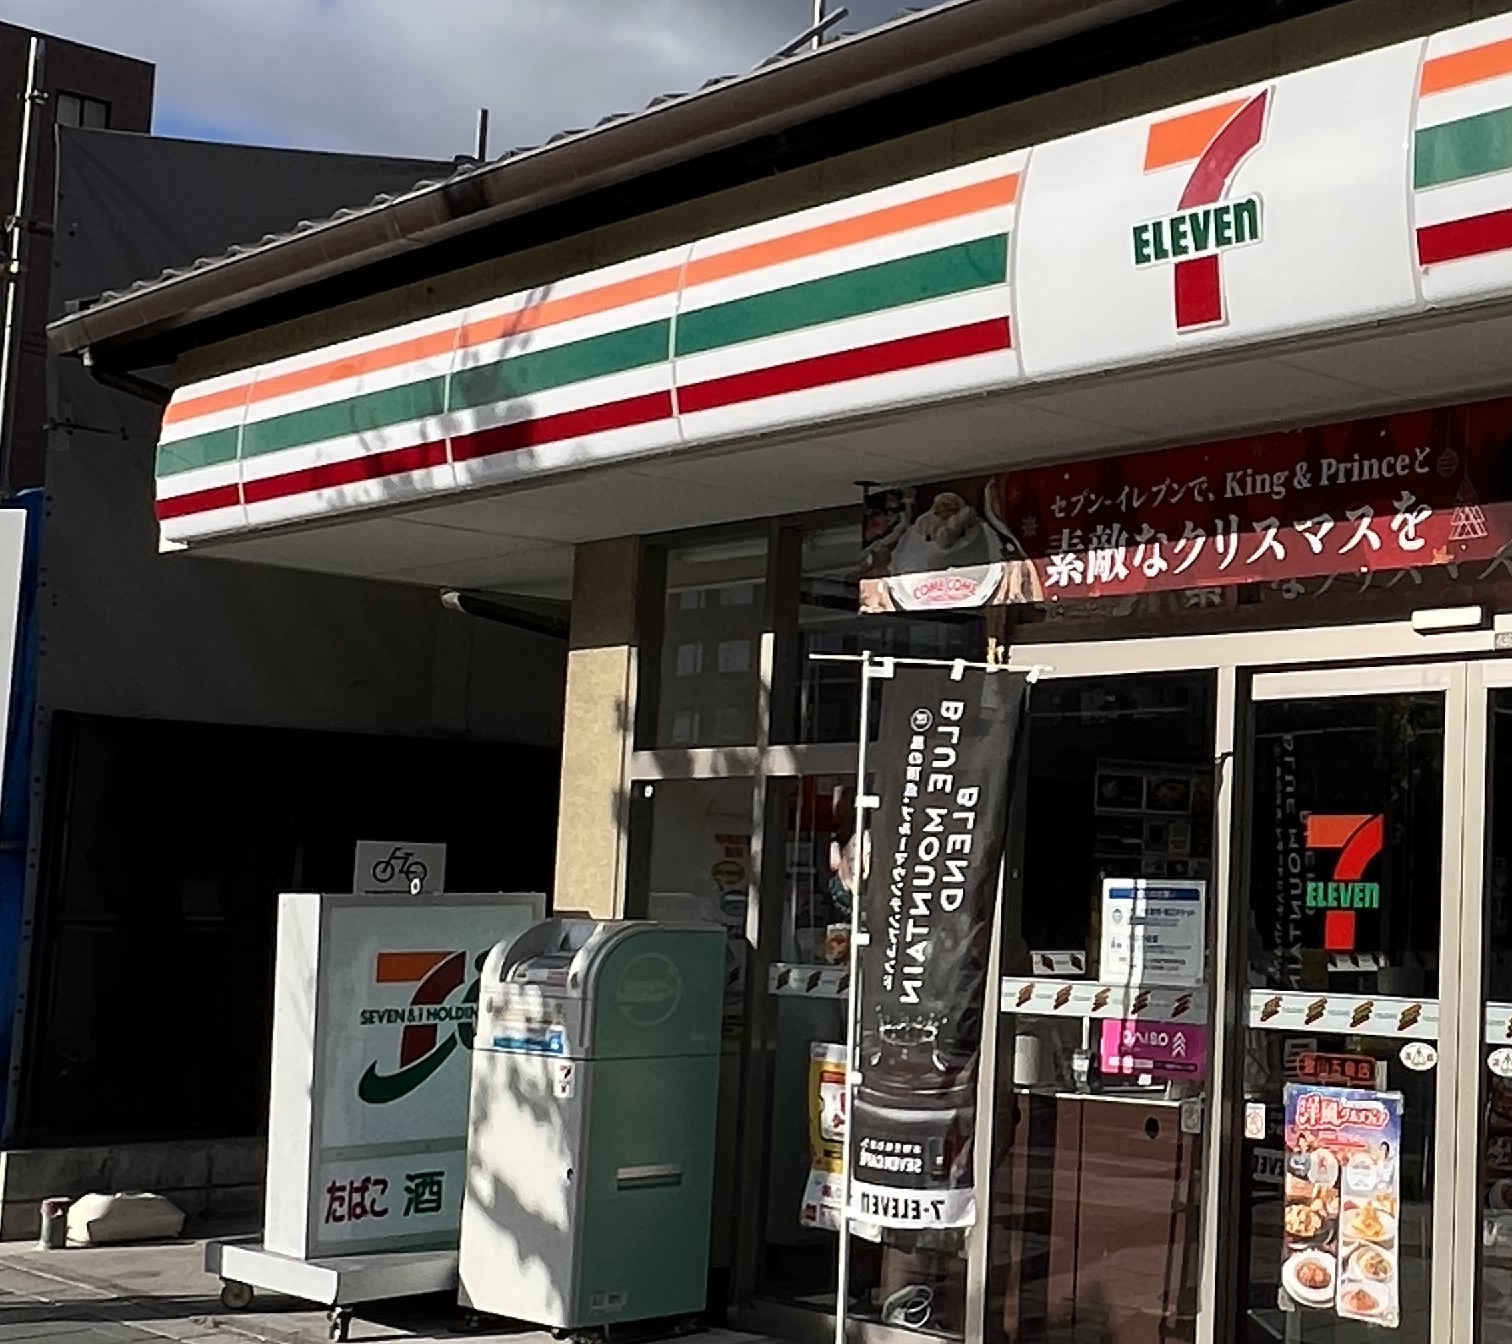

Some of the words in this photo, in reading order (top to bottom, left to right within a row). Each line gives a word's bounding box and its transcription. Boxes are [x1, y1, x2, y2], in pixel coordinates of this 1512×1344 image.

[1224, 463, 1288, 499] King
[1293, 462, 1313, 489] &
[1045, 490, 1433, 588] 素敵なクリスマスを
[426, 1003, 478, 1024] HOLDIN
[325, 1176, 390, 1224] たばこ
[402, 1169, 446, 1217] 酒
